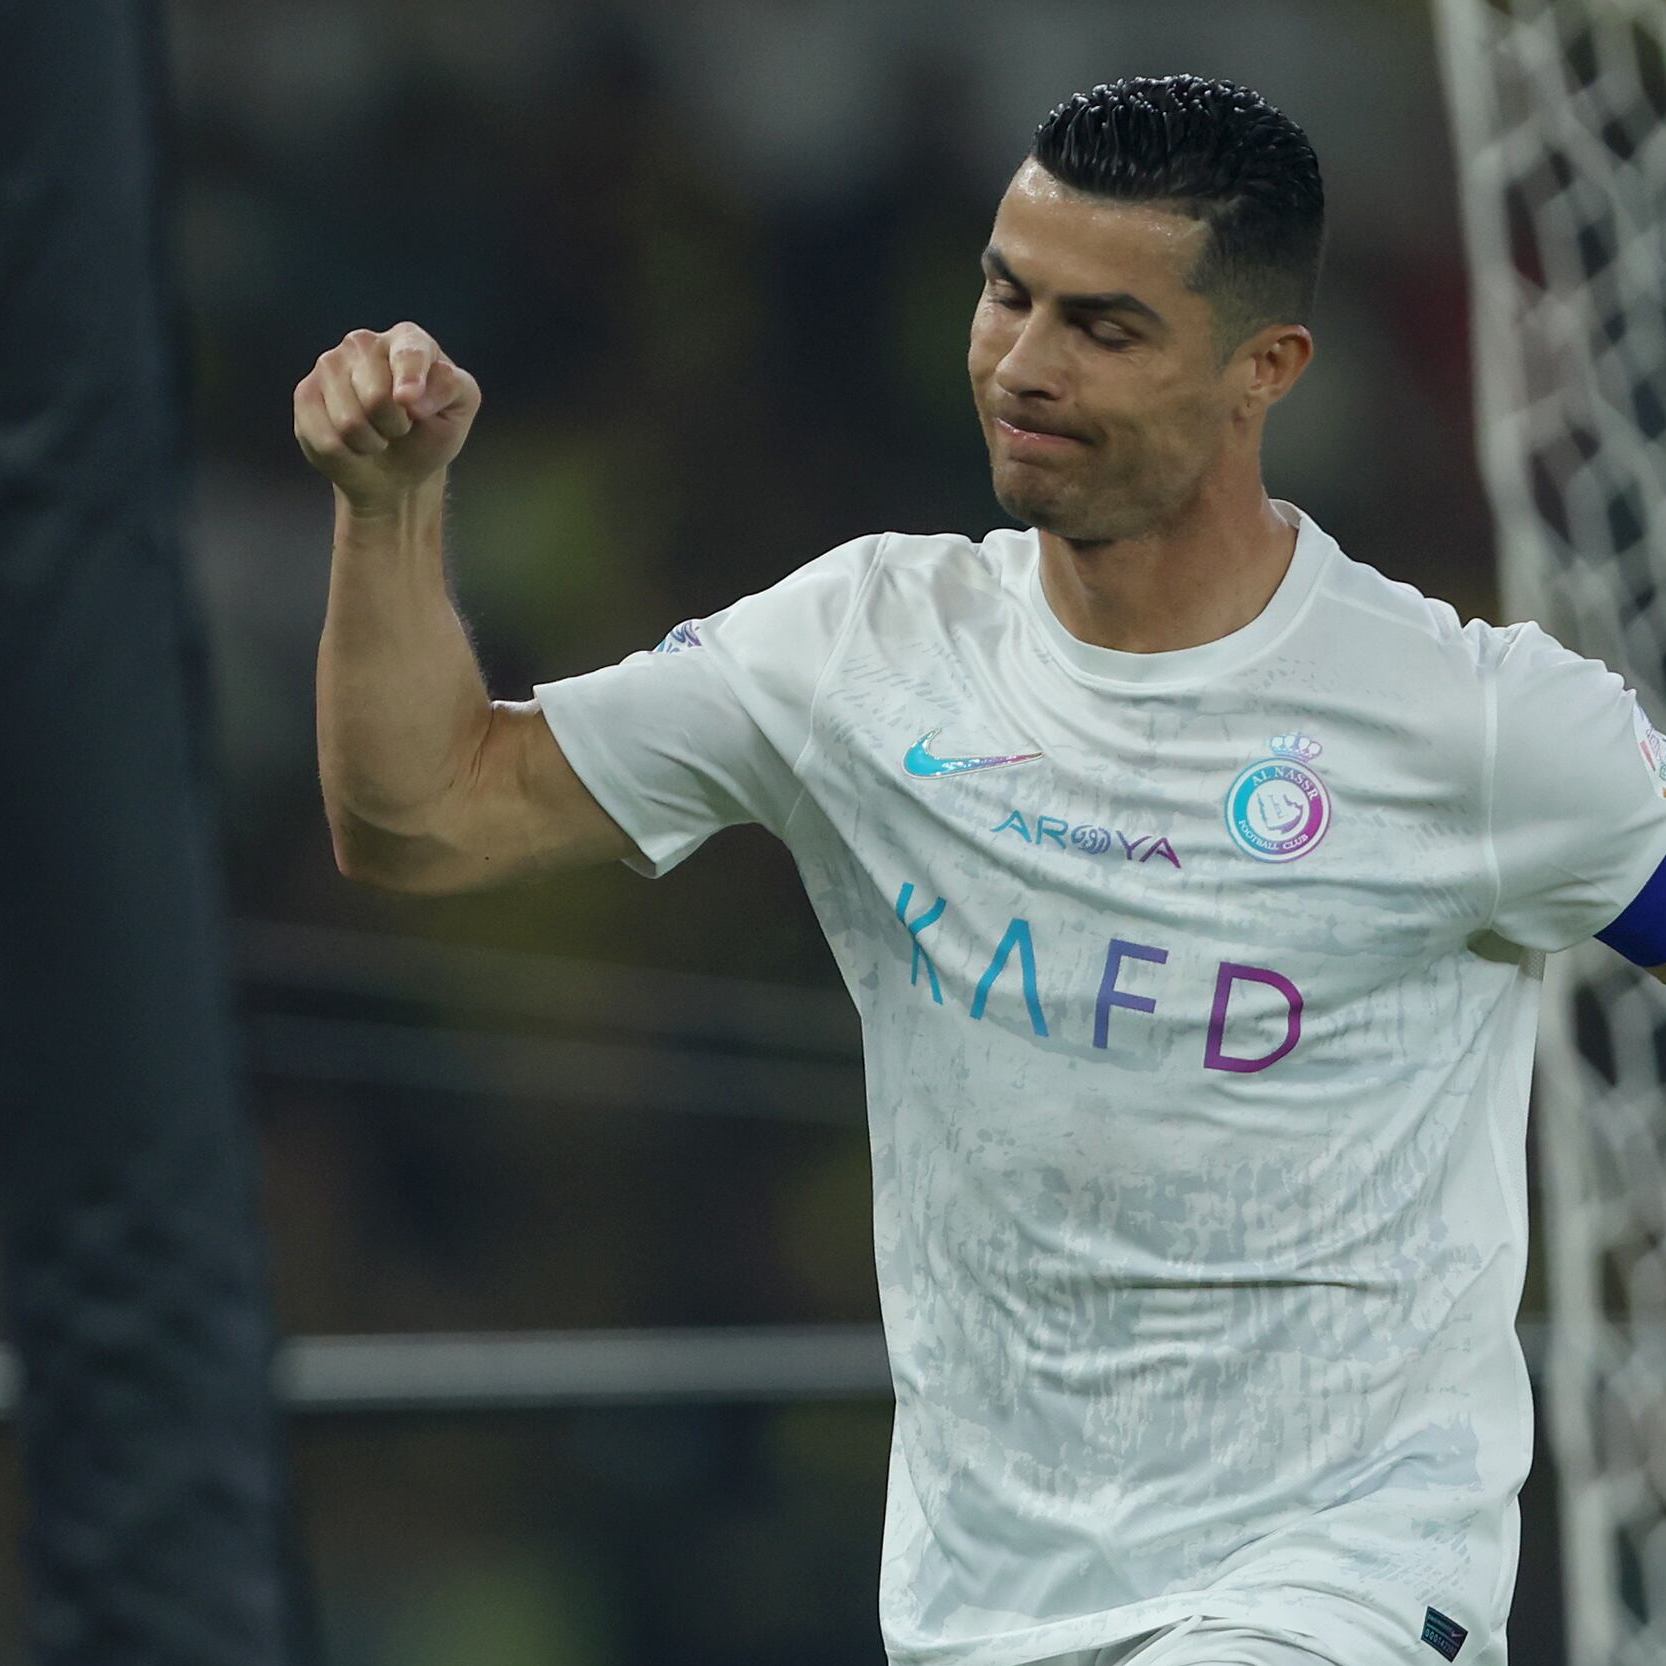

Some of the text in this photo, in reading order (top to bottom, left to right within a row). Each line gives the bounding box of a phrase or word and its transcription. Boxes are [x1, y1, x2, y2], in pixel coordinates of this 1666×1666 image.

[1252, 766, 1319, 801] AL NASSR
[989, 809, 1182, 869] AROYA
[1238, 819, 1309, 850] FOOTBALL CLUB
[895, 881, 1304, 1073] KAFD
